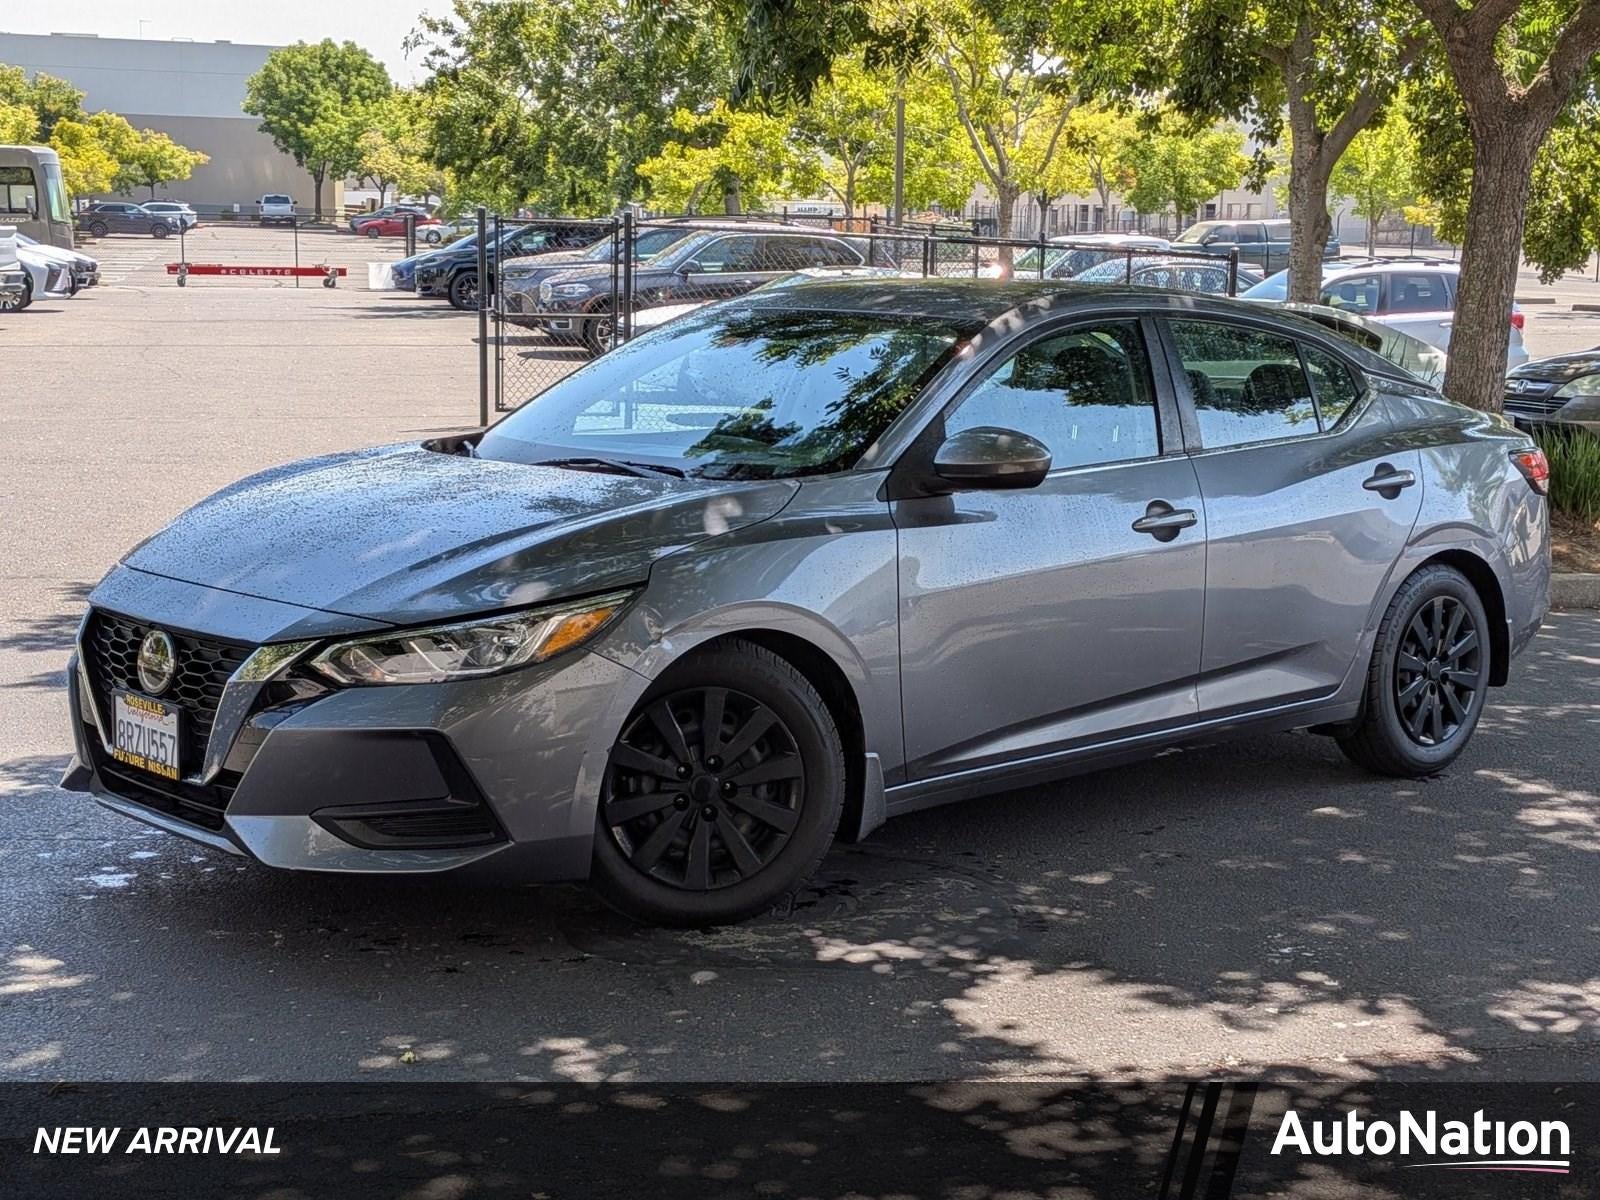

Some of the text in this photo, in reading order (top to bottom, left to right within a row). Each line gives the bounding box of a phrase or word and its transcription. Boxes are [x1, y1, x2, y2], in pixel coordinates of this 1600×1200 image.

[126, 694, 163, 715] ROSEVILLE
[118, 719, 176, 768] 8RZU557
[113, 747, 177, 780] FUTURE NISSAN
